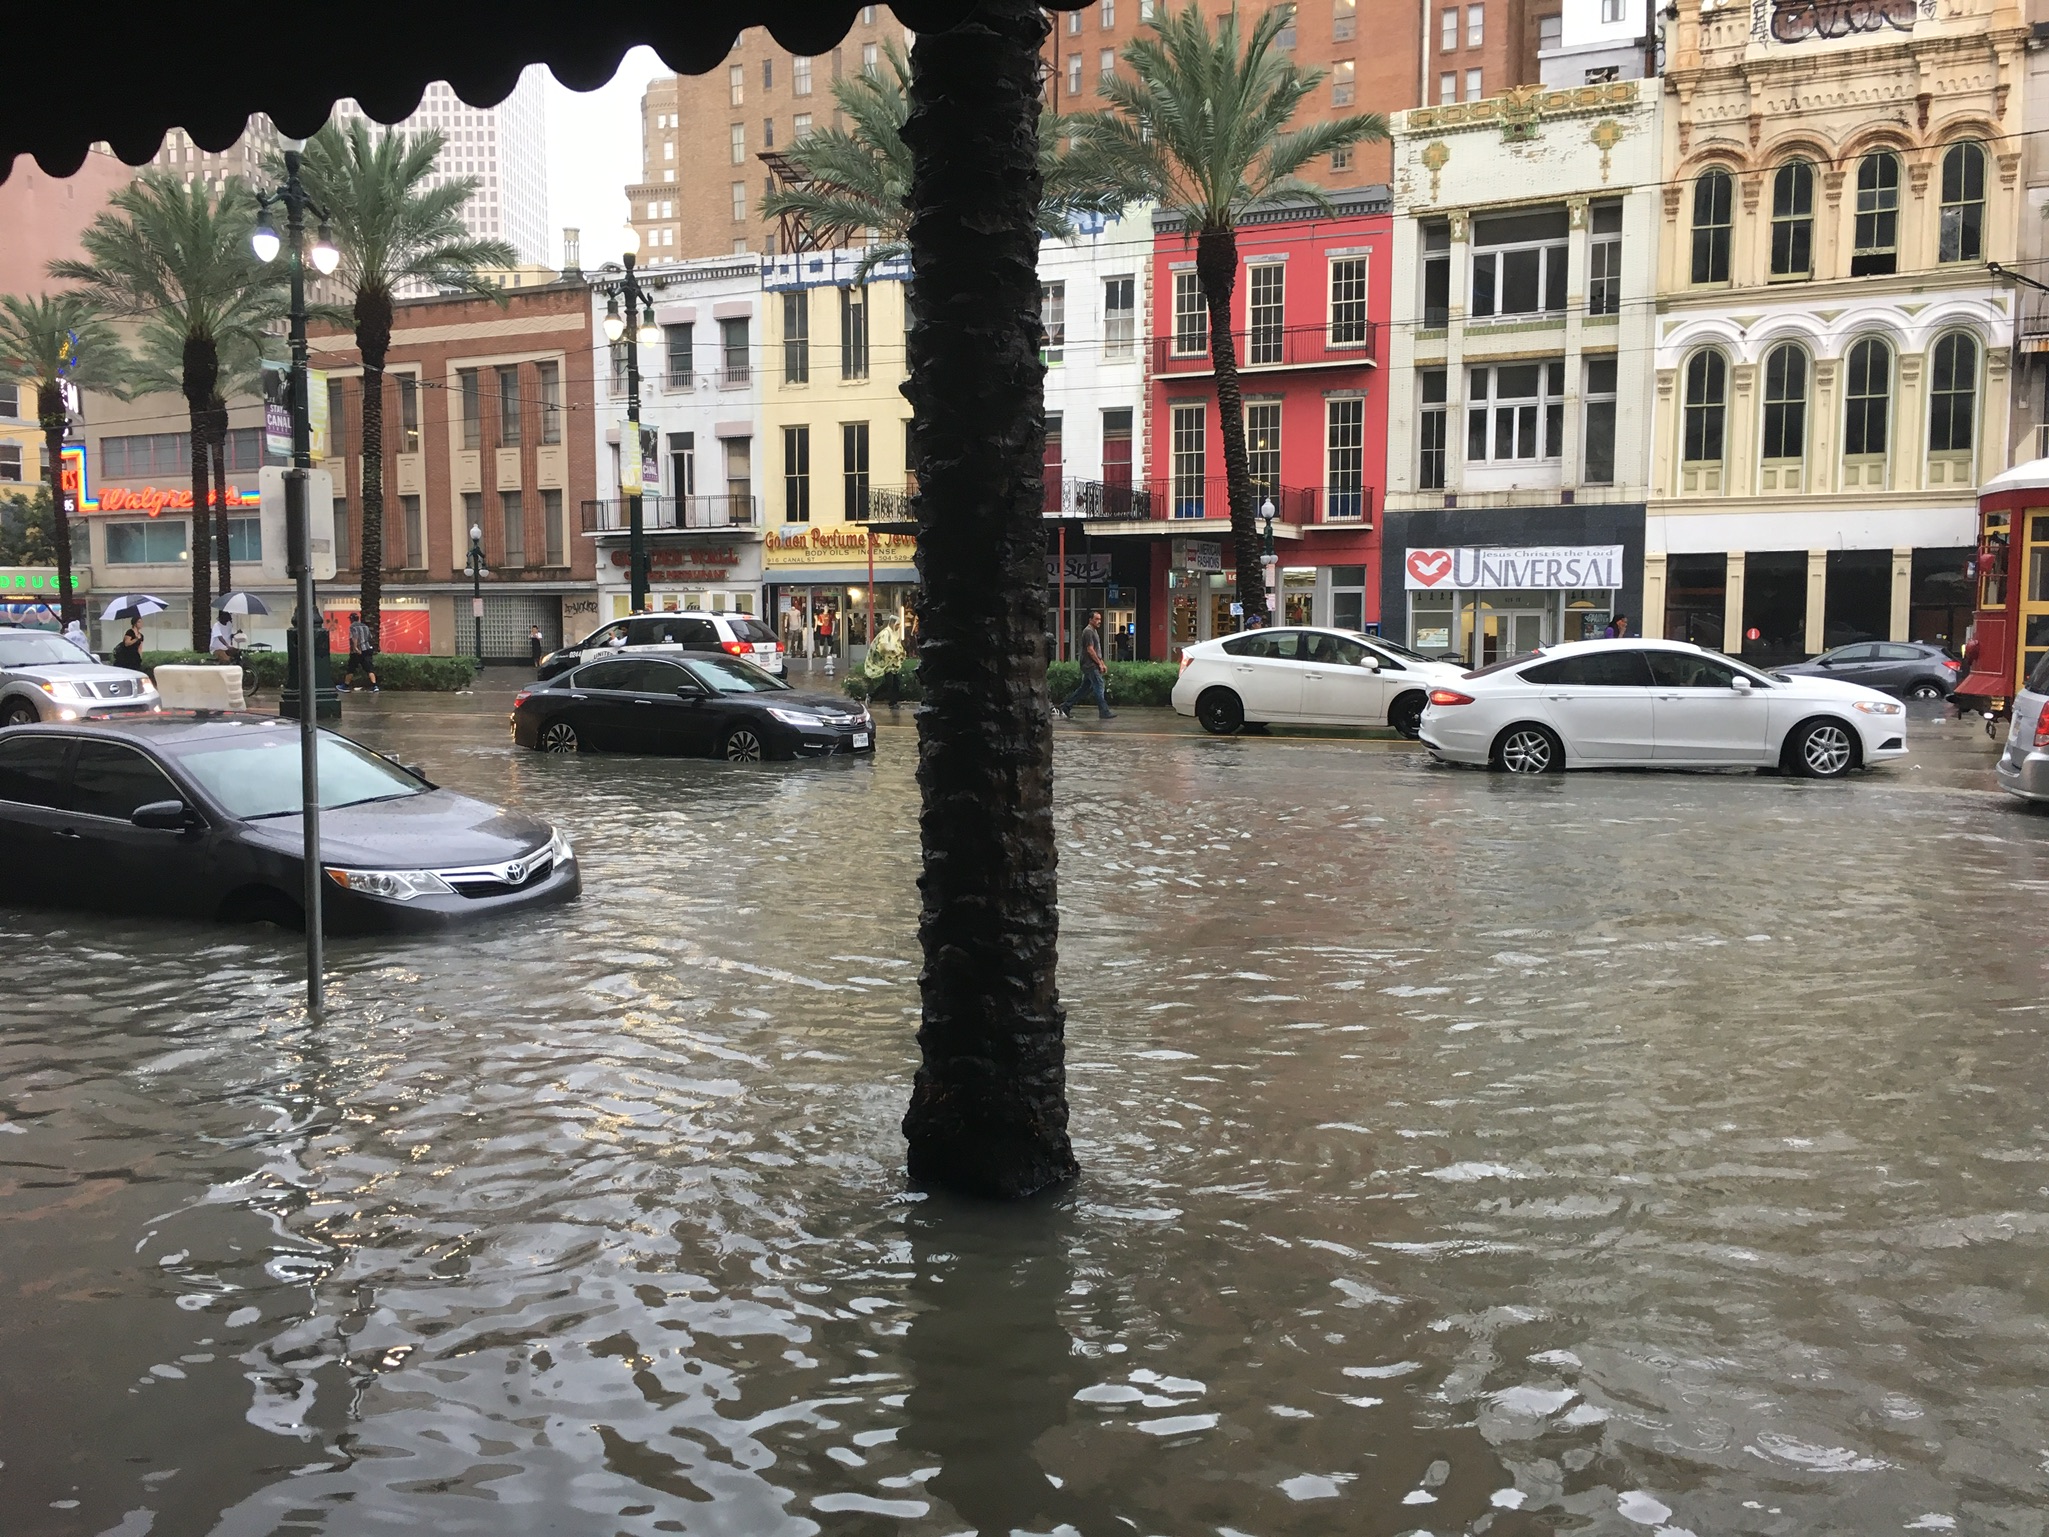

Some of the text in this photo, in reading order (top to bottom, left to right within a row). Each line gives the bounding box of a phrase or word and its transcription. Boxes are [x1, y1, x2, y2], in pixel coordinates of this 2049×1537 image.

[270, 405, 284, 413] STAY
[267, 414, 292, 428] CANAL
[811, 527, 866, 549] Perfume
[1564, 549, 1583, 557] the
[1586, 549, 1613, 557] Lord
[1064, 558, 1104, 579] Spa
[1453, 549, 1620, 587] UNIVERSAL
[593, 650, 614, 660] UNITE
